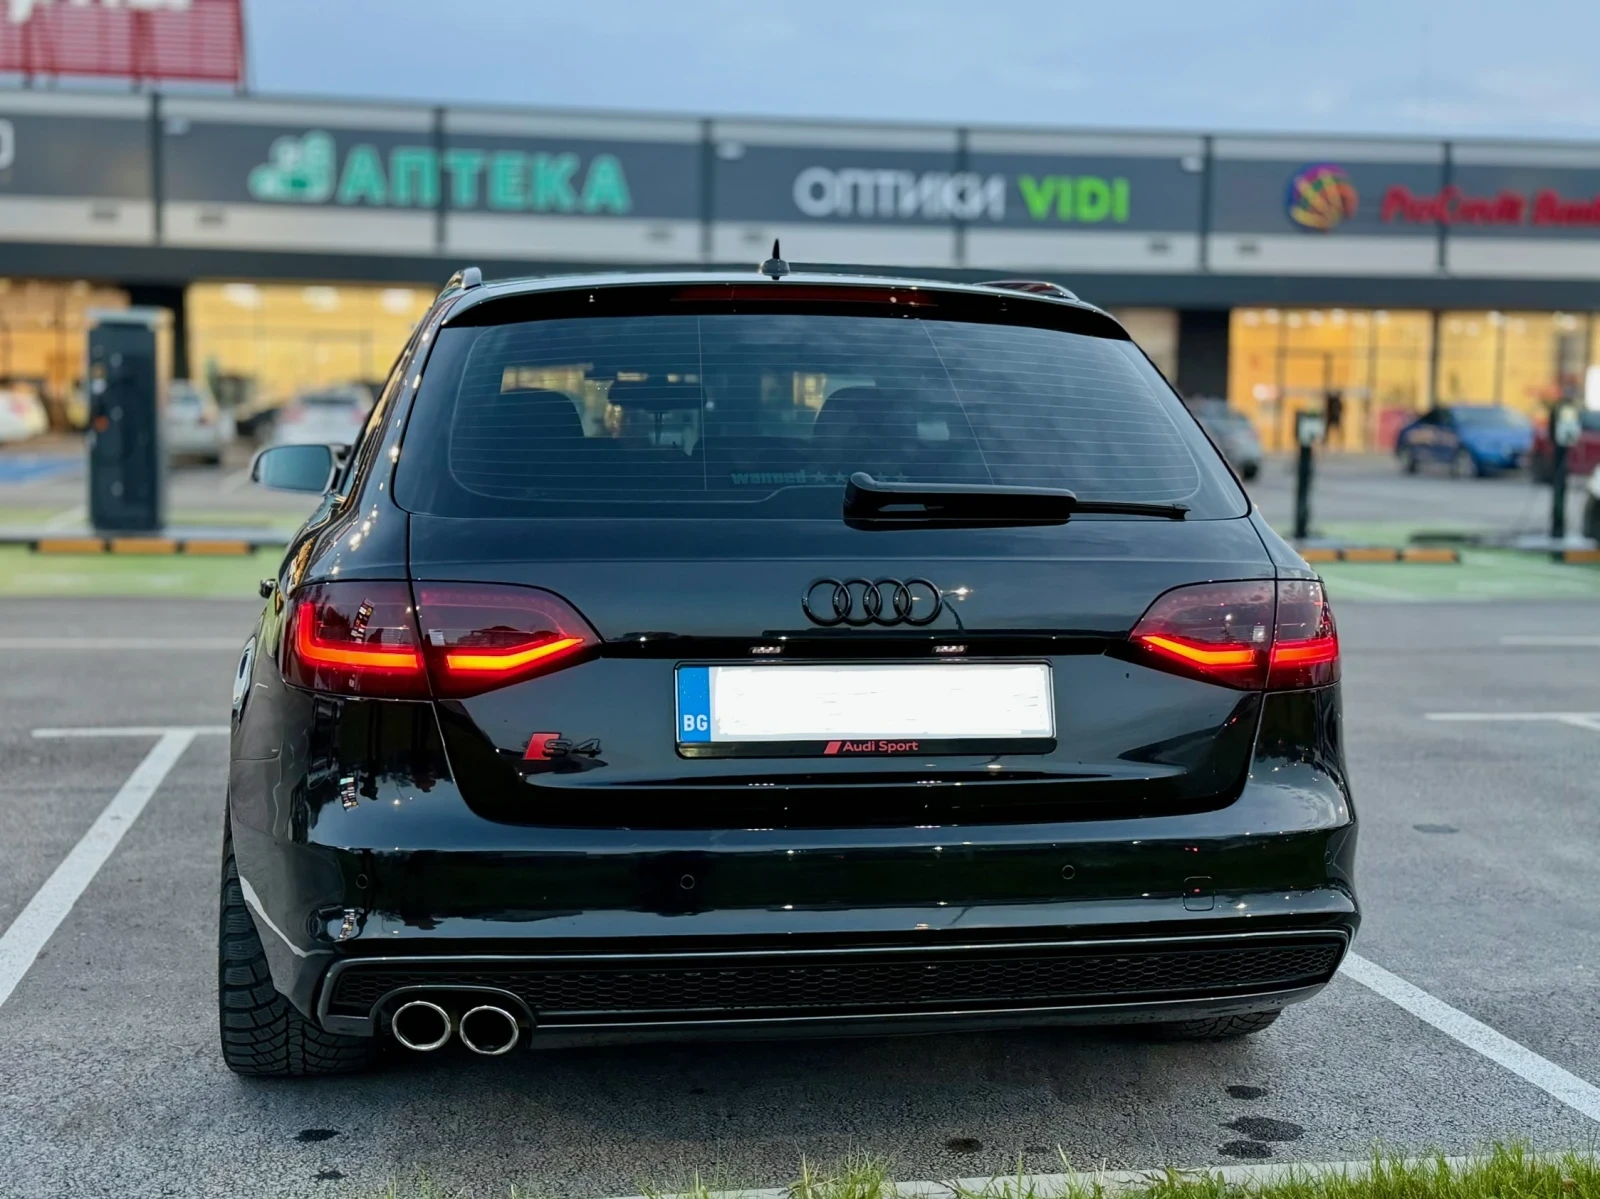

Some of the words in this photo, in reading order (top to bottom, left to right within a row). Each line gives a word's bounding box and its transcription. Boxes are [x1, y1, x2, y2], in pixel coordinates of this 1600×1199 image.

[338, 143, 632, 214] АПТЕКА
[793, 166, 1006, 222] ОПТИКИ
[1017, 174, 1131, 222] VIDI
[683, 714, 708, 731] BG
[542, 738, 602, 758] S4
[842, 741, 875, 752] Audi
[878, 741, 919, 753] Sport
